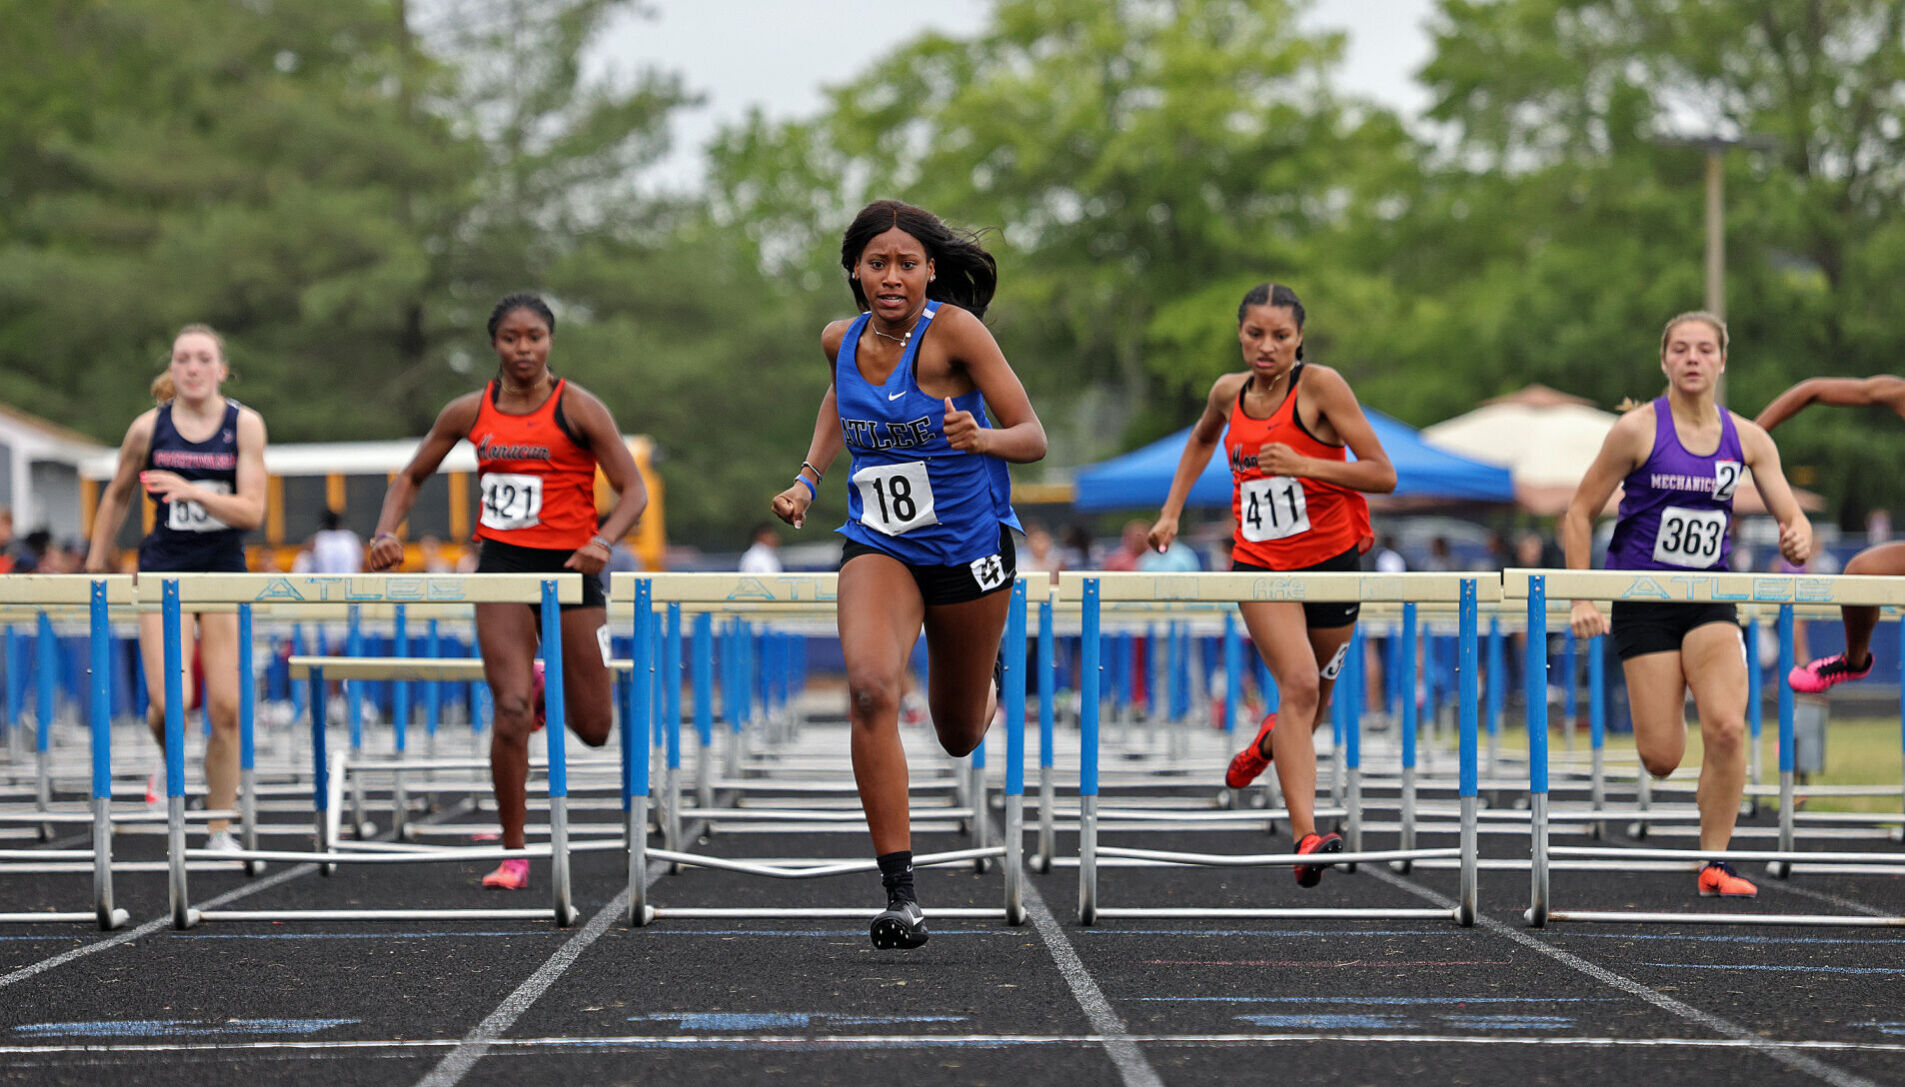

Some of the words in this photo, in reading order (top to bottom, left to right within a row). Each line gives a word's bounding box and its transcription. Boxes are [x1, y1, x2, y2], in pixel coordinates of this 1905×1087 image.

[1716, 466, 1735, 496] 2
[486, 484, 532, 519] 421
[872, 475, 916, 524] 18
[1246, 485, 1299, 530] 411
[1662, 517, 1720, 556] 363
[254, 576, 467, 601] ATLEE
[1621, 575, 1836, 602] ATLEE
